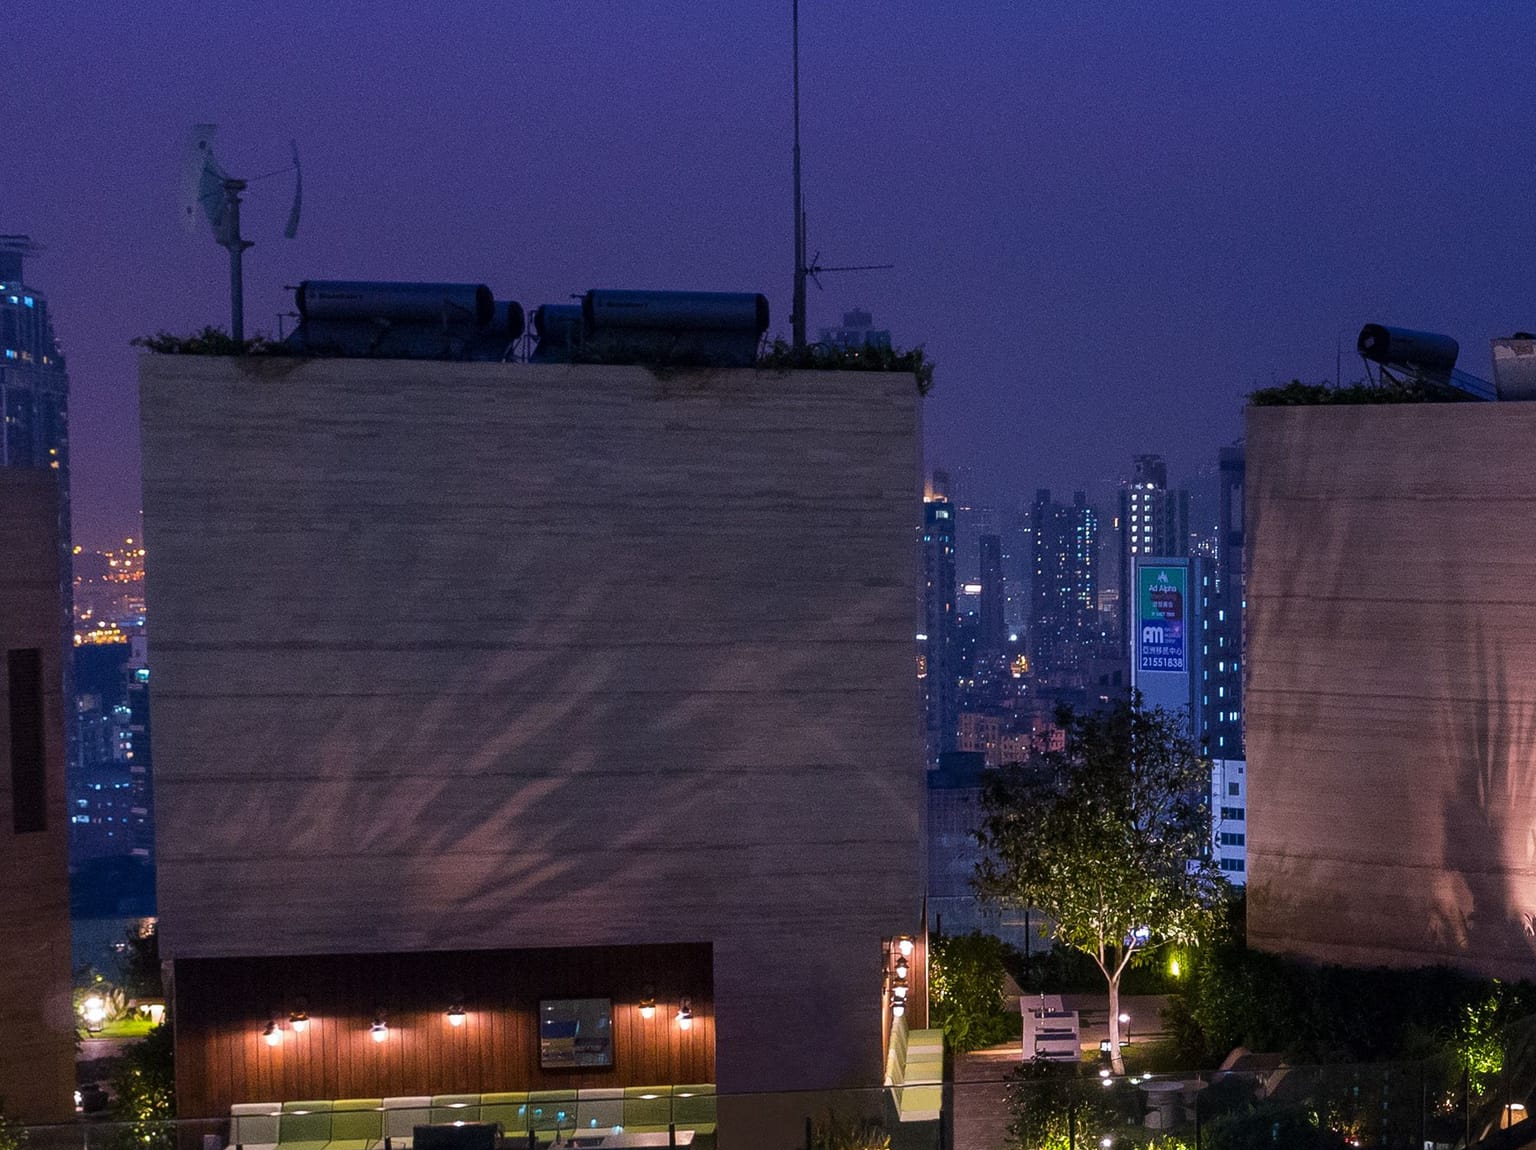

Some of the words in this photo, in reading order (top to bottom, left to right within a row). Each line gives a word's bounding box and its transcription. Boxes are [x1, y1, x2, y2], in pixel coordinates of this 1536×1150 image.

[1159, 584, 1177, 593] Alpha
[1143, 626, 1164, 643] AM
[1143, 657, 1183, 667] 21551838
